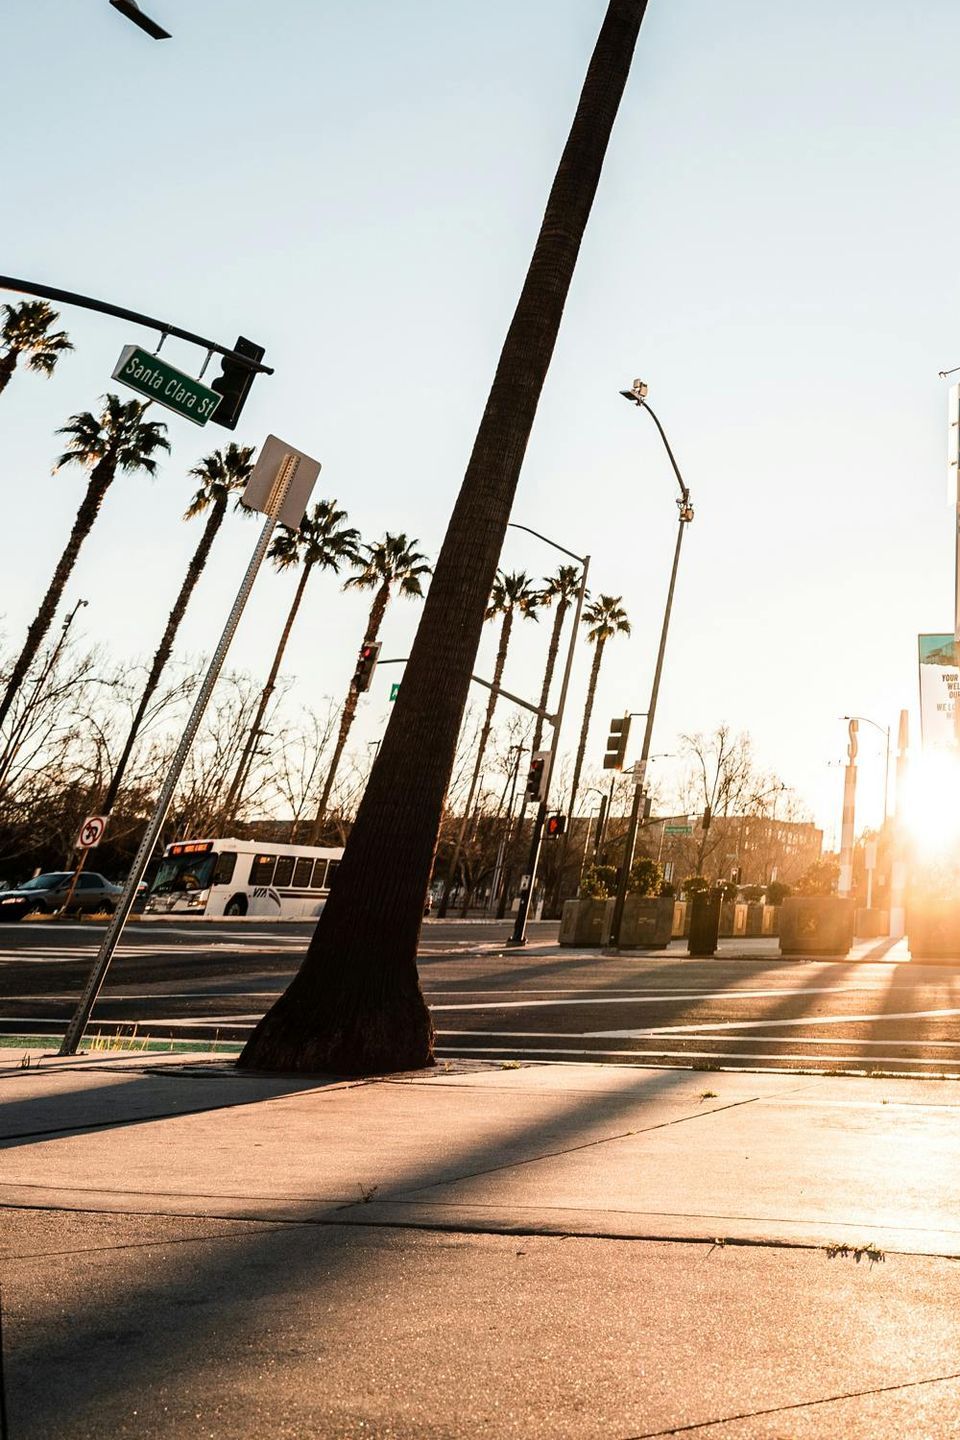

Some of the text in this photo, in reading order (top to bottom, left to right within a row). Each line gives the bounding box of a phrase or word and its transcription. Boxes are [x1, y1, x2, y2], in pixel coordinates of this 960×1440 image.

[126, 358, 214, 416] Santa Clara St
[253, 887, 268, 898] VTA
